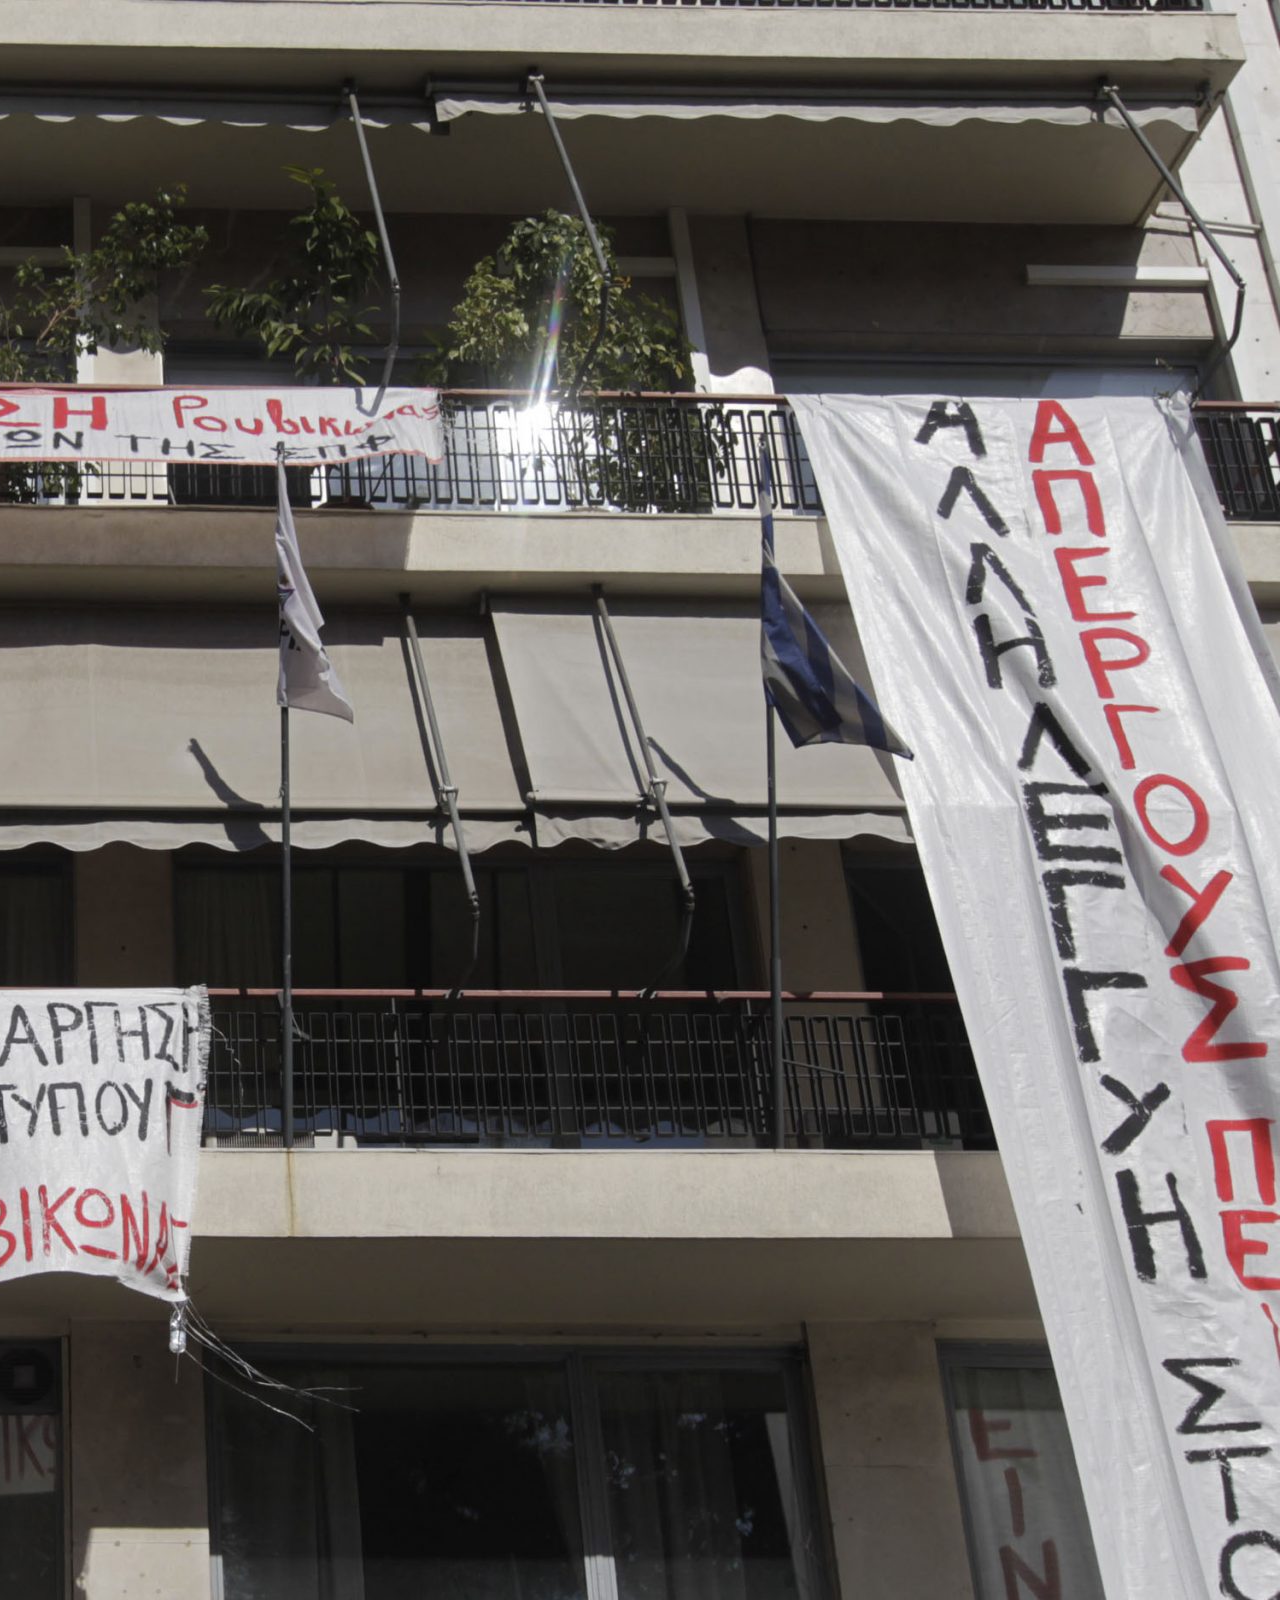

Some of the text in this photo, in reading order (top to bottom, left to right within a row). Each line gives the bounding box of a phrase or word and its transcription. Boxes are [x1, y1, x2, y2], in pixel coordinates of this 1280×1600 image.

[115, 433, 245, 460] ΤΗΣ
[1028, 399, 1268, 1063] ΑΠΕΡΓΟΥΣ
[915, 401, 1208, 1283] ΑΛΛΗΛΕΓΓΥΗ
